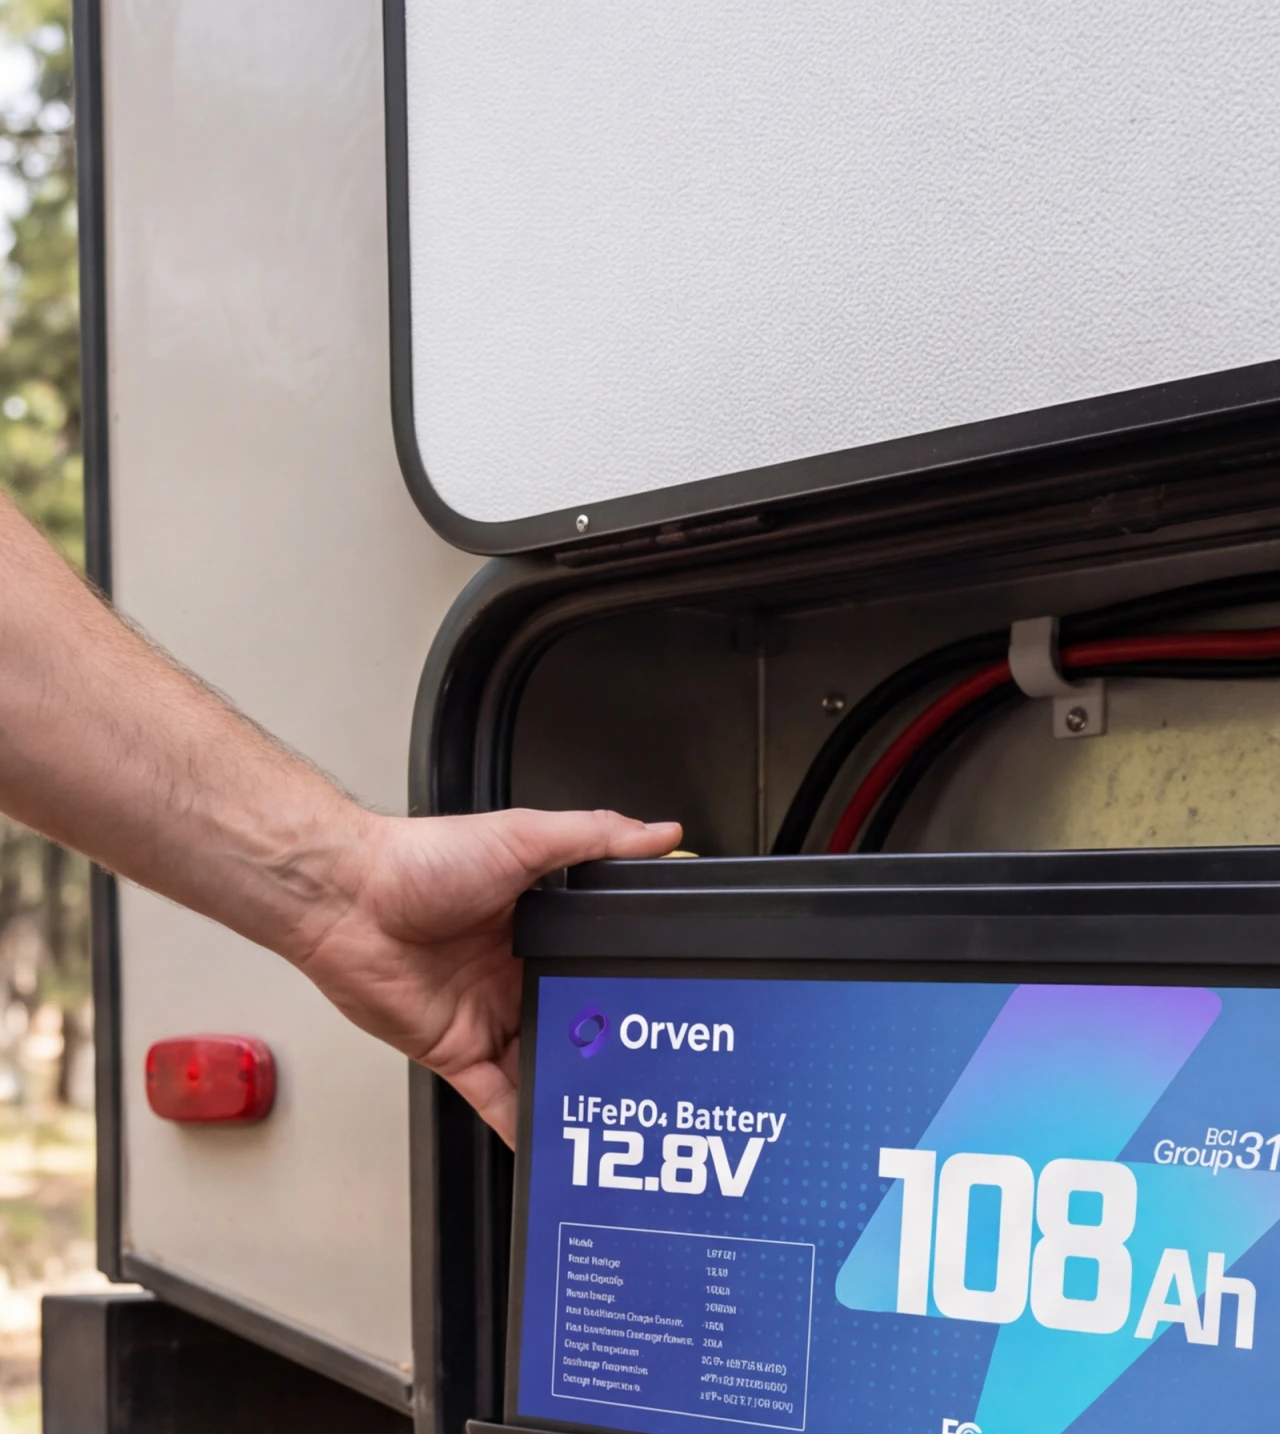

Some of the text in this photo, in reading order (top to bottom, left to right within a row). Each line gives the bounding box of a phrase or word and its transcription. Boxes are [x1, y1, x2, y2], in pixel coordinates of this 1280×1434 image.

[620, 1013, 734, 1052] Orven
[676, 1101, 787, 1142] Battery
[1205, 1127, 1238, 1146] BCI
[563, 1127, 765, 1197] 12.8V
[1153, 1139, 1233, 1176] Group
[878, 1147, 1256, 1350] 108 Ah
